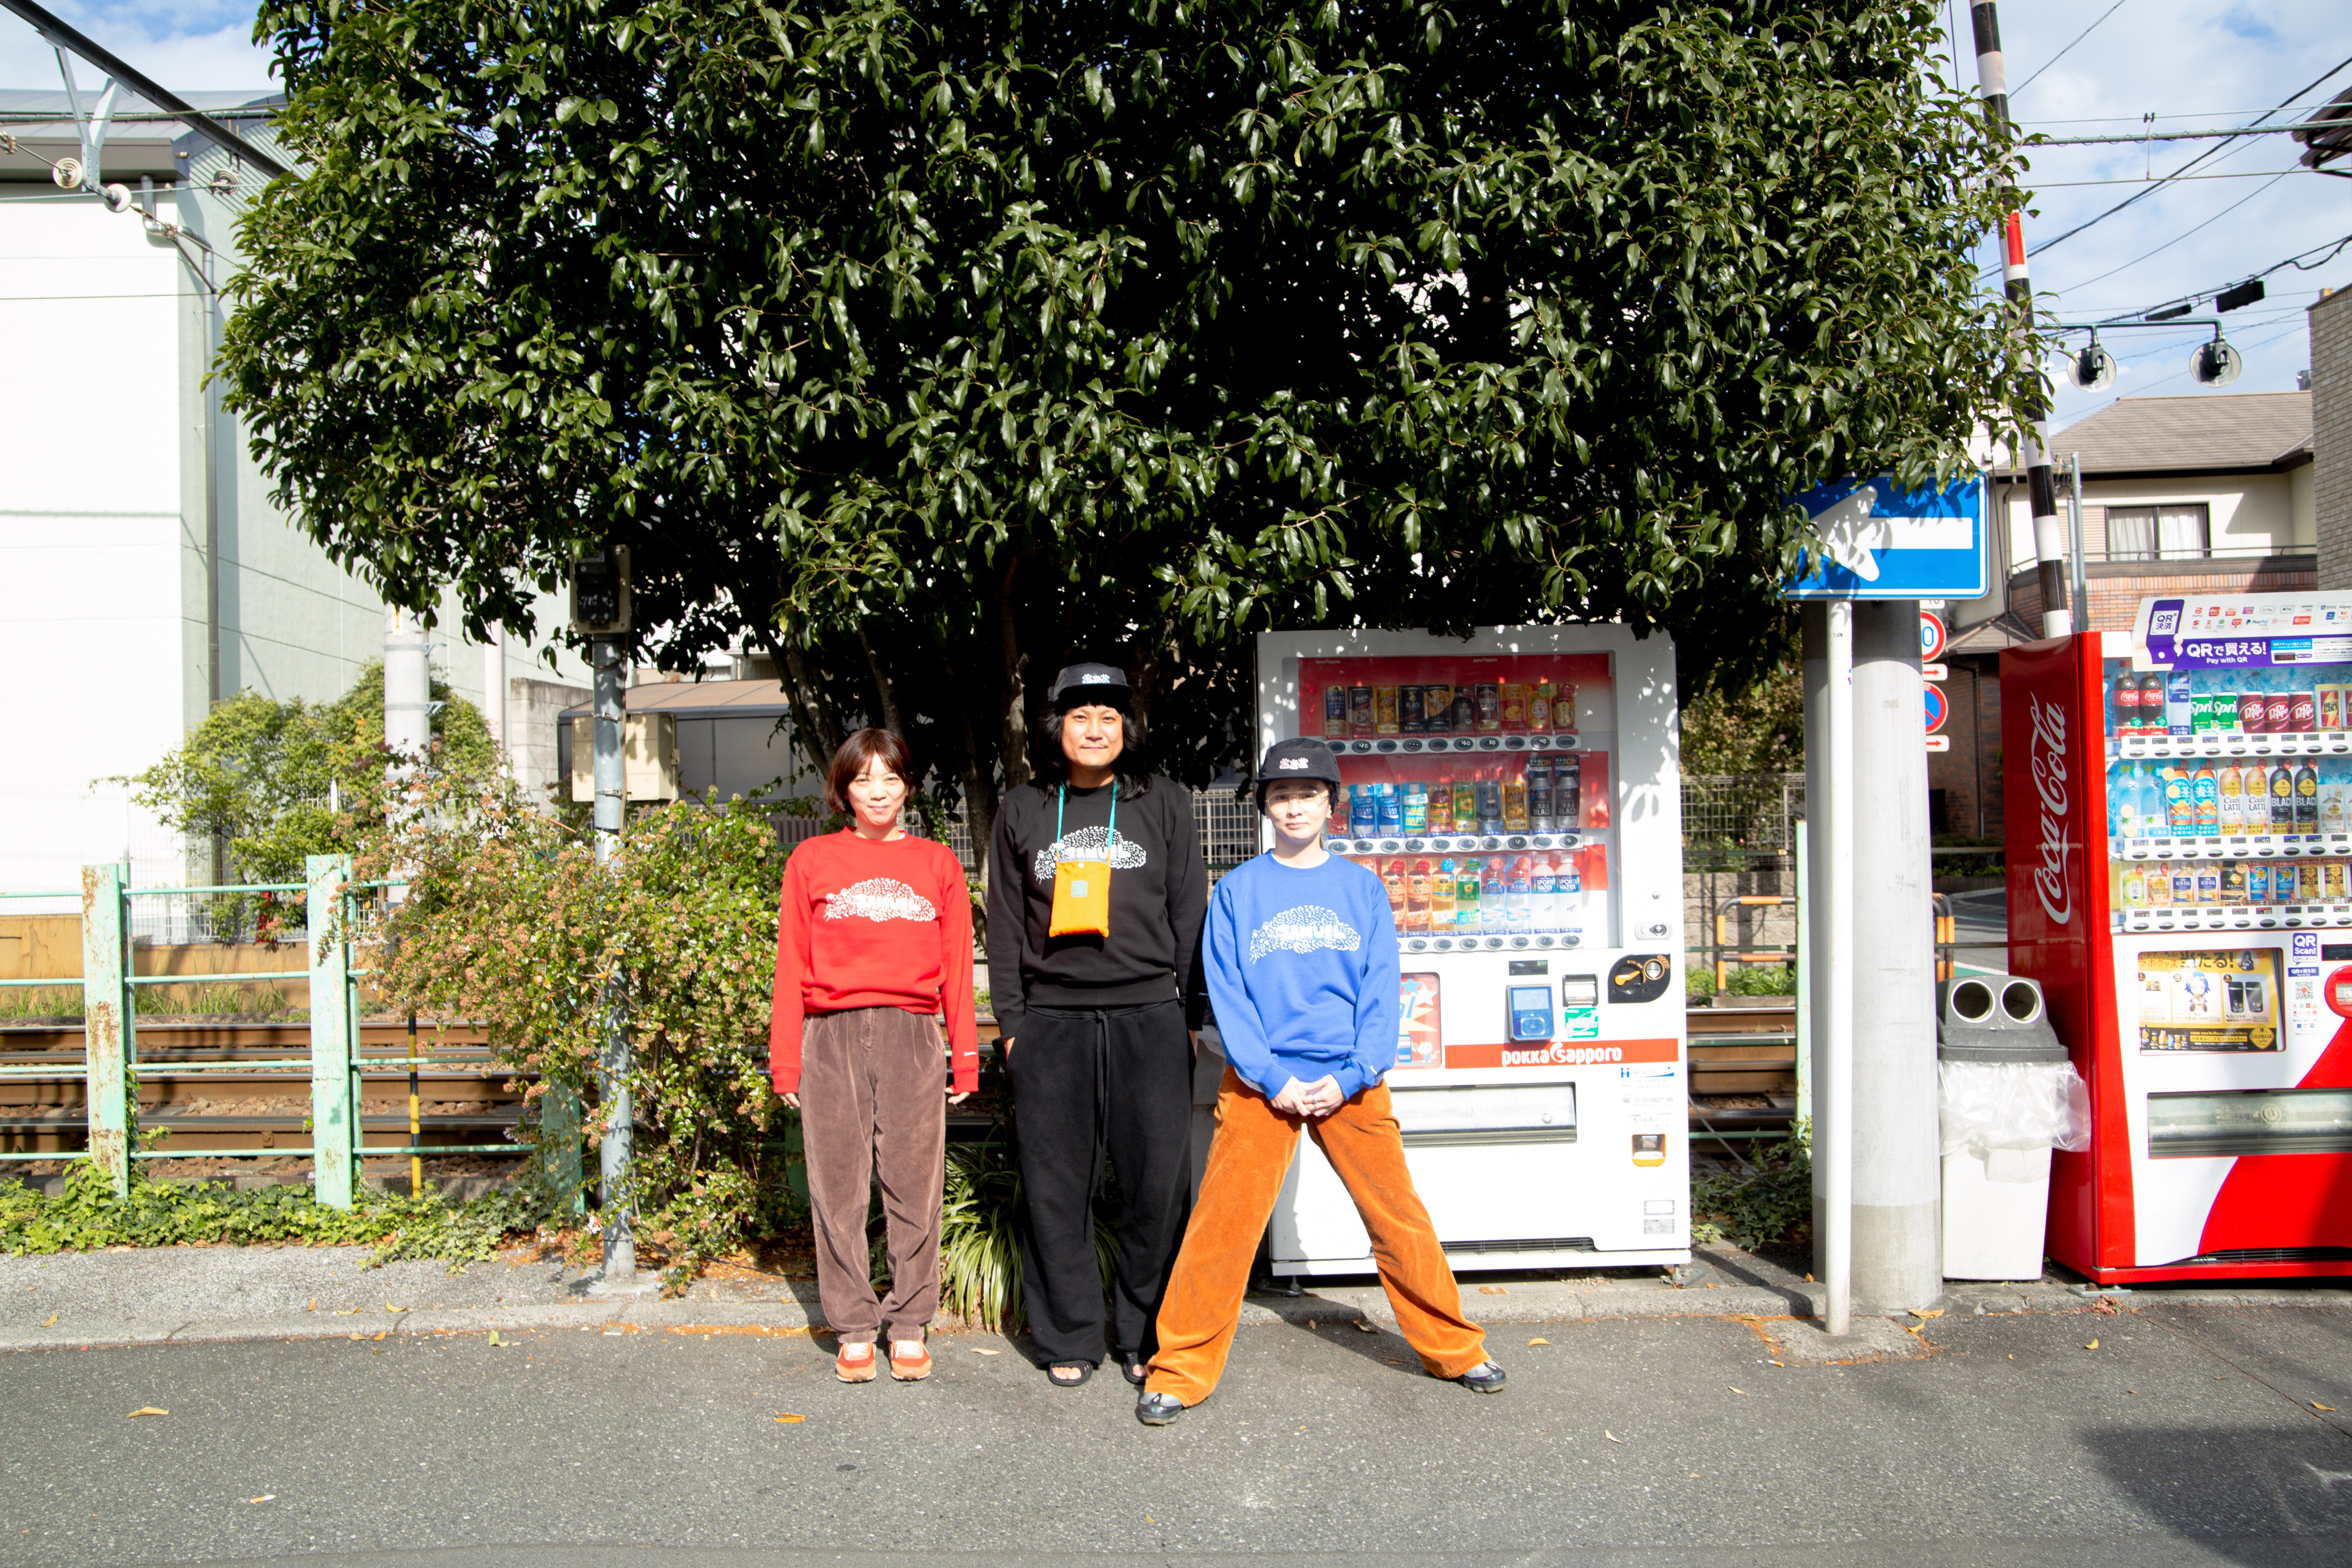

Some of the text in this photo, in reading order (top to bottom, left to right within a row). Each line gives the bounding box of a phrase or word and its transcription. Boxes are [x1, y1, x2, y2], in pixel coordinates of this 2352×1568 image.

[2187, 642, 2266, 658] QRで買える!
[2191, 701, 2212, 716] Spri
[2213, 701, 2237, 716] Spri
[2245, 708, 2263, 719] Peppe
[2269, 708, 2288, 720] Peppe
[2295, 708, 2313, 719] Peppe
[2194, 786, 2215, 797] 麦茶
[2030, 690, 2071, 924] Coca-Cola
[1278, 924, 1347, 941] SAMUEL
[2294, 935, 2316, 947] QR
[2180, 951, 2234, 969] 当たる!
